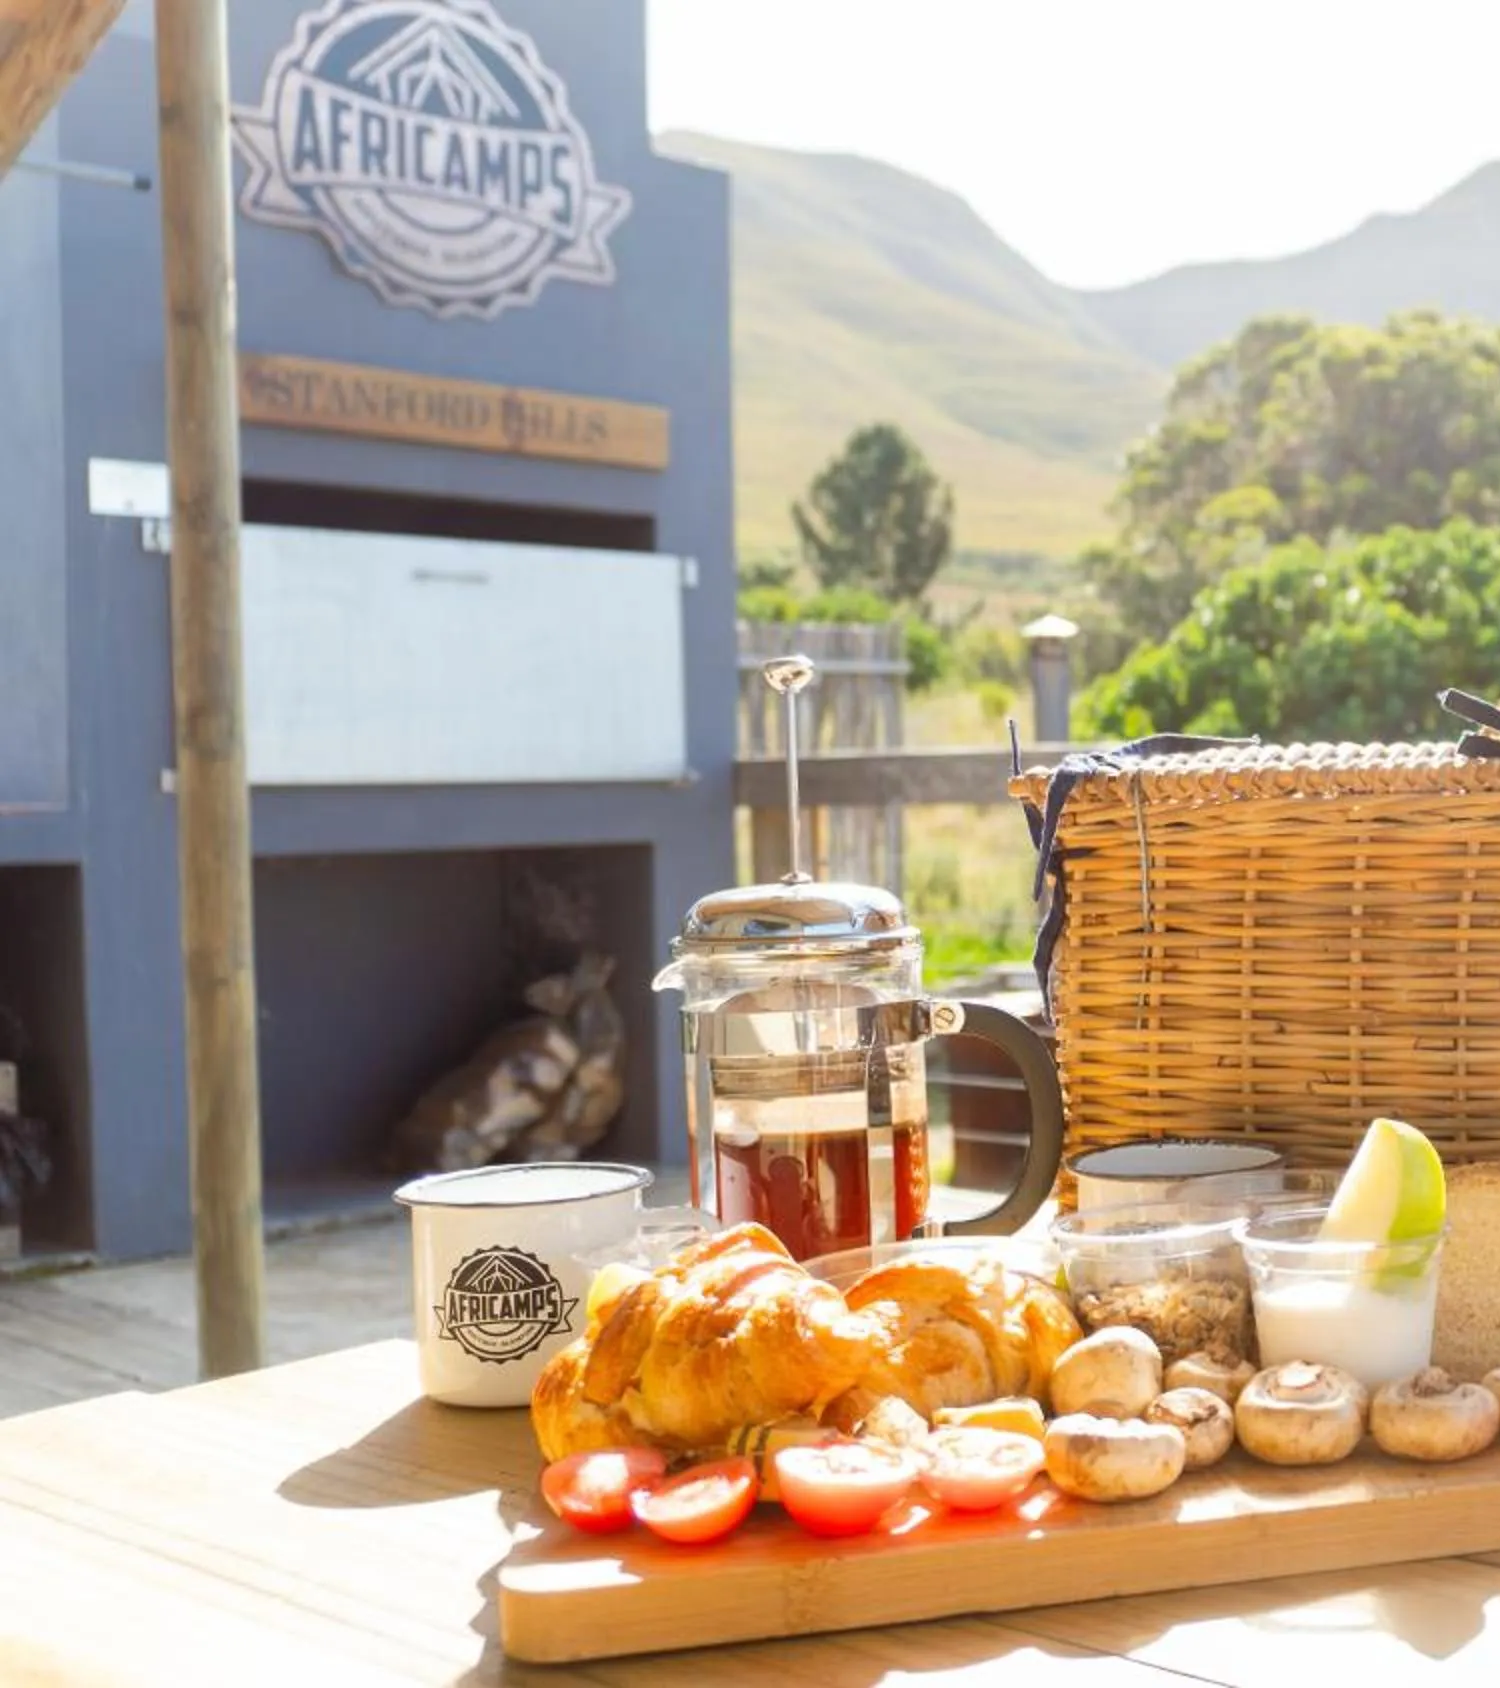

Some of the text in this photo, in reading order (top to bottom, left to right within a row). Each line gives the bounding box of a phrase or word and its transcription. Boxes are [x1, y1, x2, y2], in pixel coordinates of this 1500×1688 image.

[293, 86, 572, 224] AFRICAMPS
[277, 367, 490, 430] STANFORD
[449, 1285, 558, 1324] AFRICAMPS
